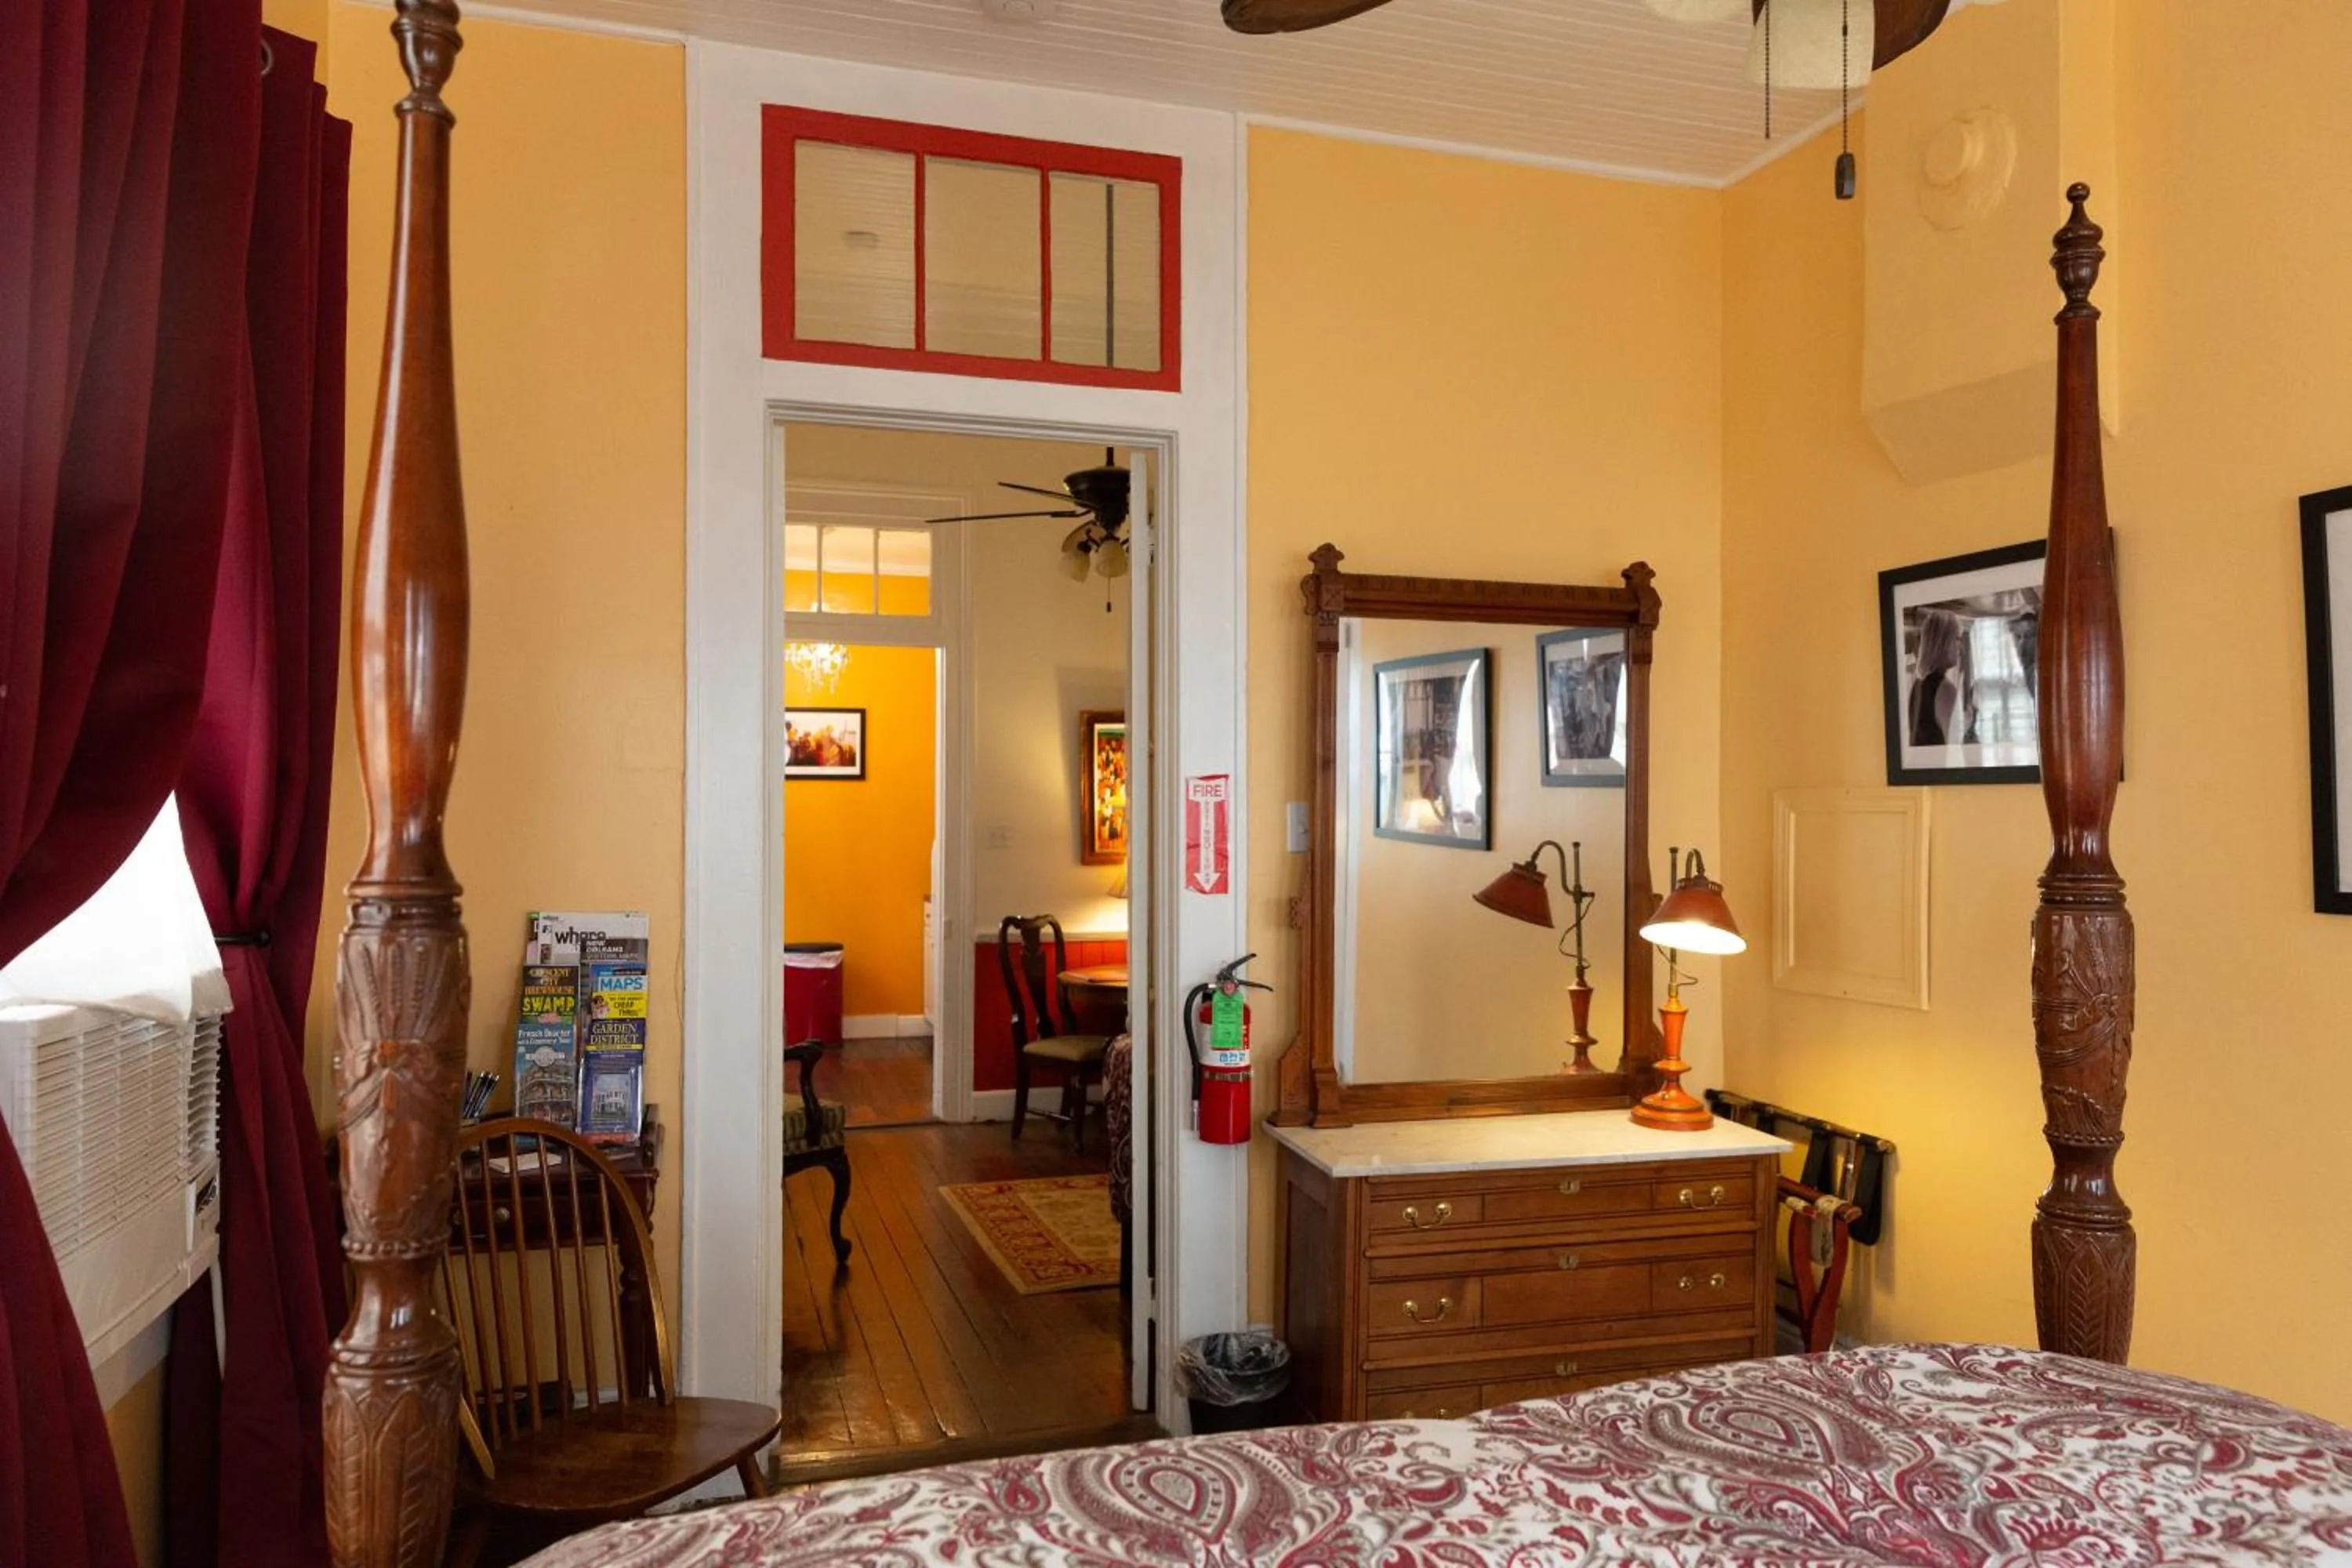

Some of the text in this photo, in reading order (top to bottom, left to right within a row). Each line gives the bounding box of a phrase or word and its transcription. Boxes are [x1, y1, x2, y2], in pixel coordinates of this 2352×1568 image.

[1192, 785, 1222, 797] FIRE
[601, 977, 643, 991] MAPS
[523, 996, 575, 1012] SWAMP
[592, 1023, 637, 1033] GARDEN
[590, 1034, 639, 1045] DISTRICT
